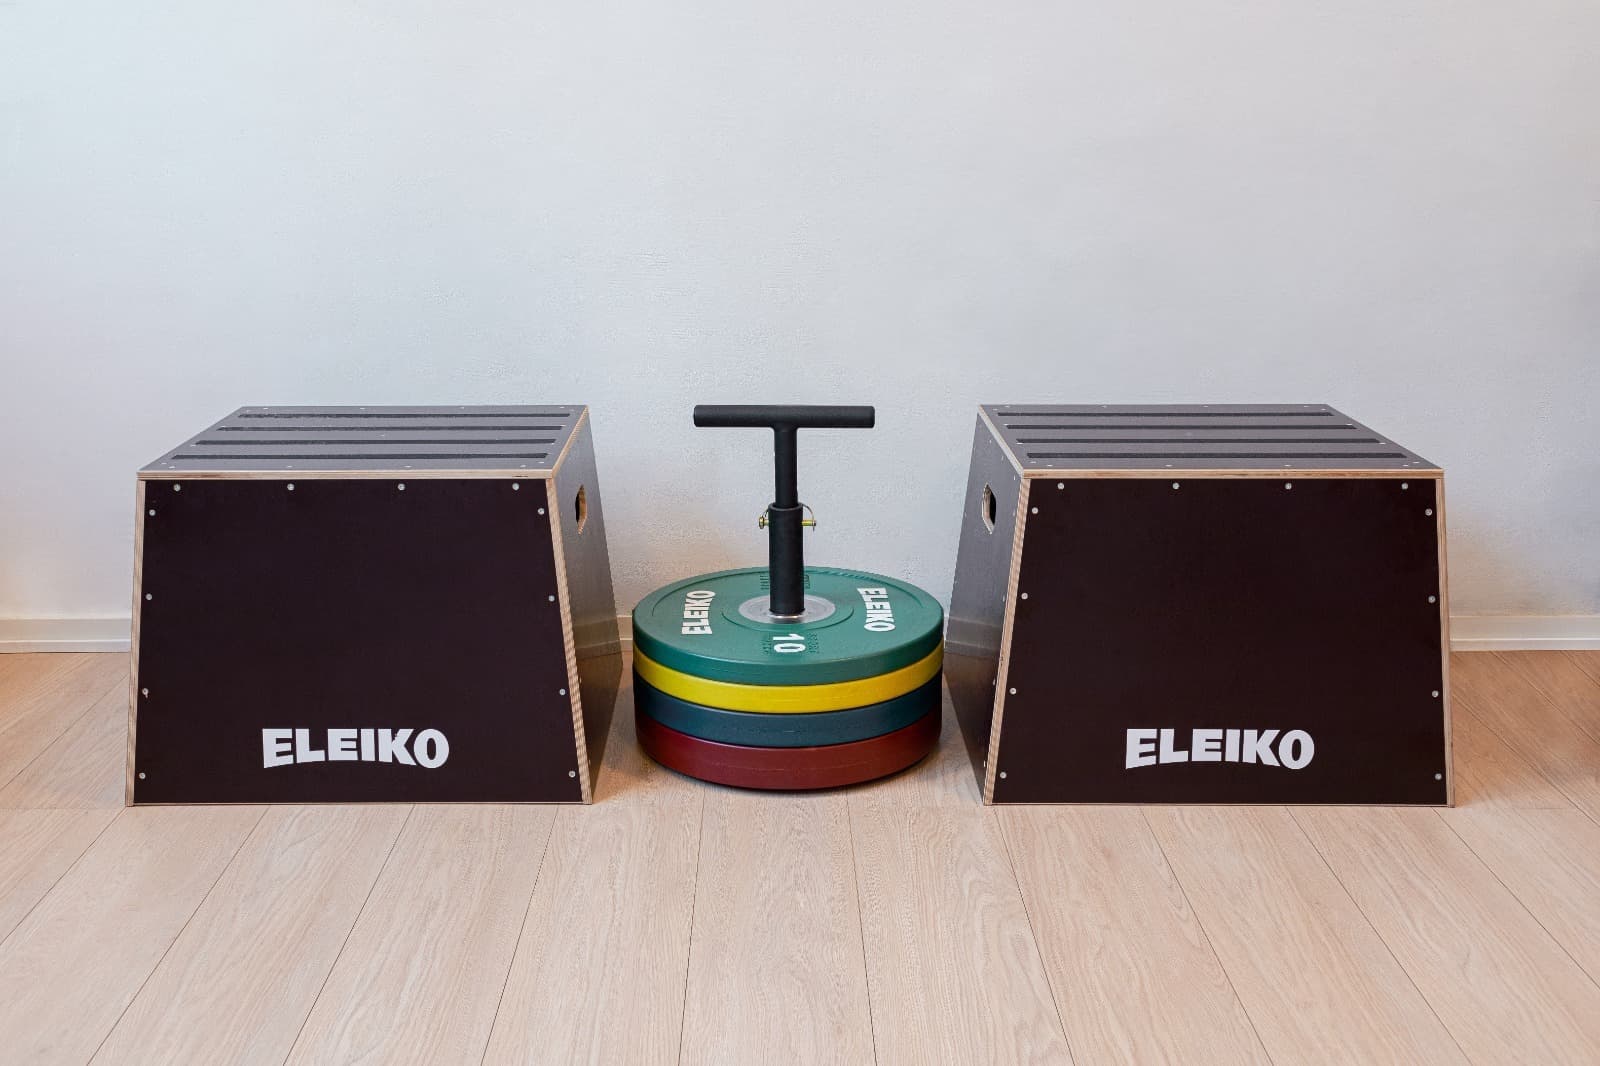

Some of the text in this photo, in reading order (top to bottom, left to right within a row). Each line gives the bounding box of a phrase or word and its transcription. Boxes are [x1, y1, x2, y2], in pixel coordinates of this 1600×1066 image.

[682, 590, 716, 635] ELEIKO
[856, 587, 896, 632] ELEIKO
[772, 633, 807, 653] 10
[262, 728, 450, 769] ELEIKO
[1125, 728, 1315, 770] ELEIKO
